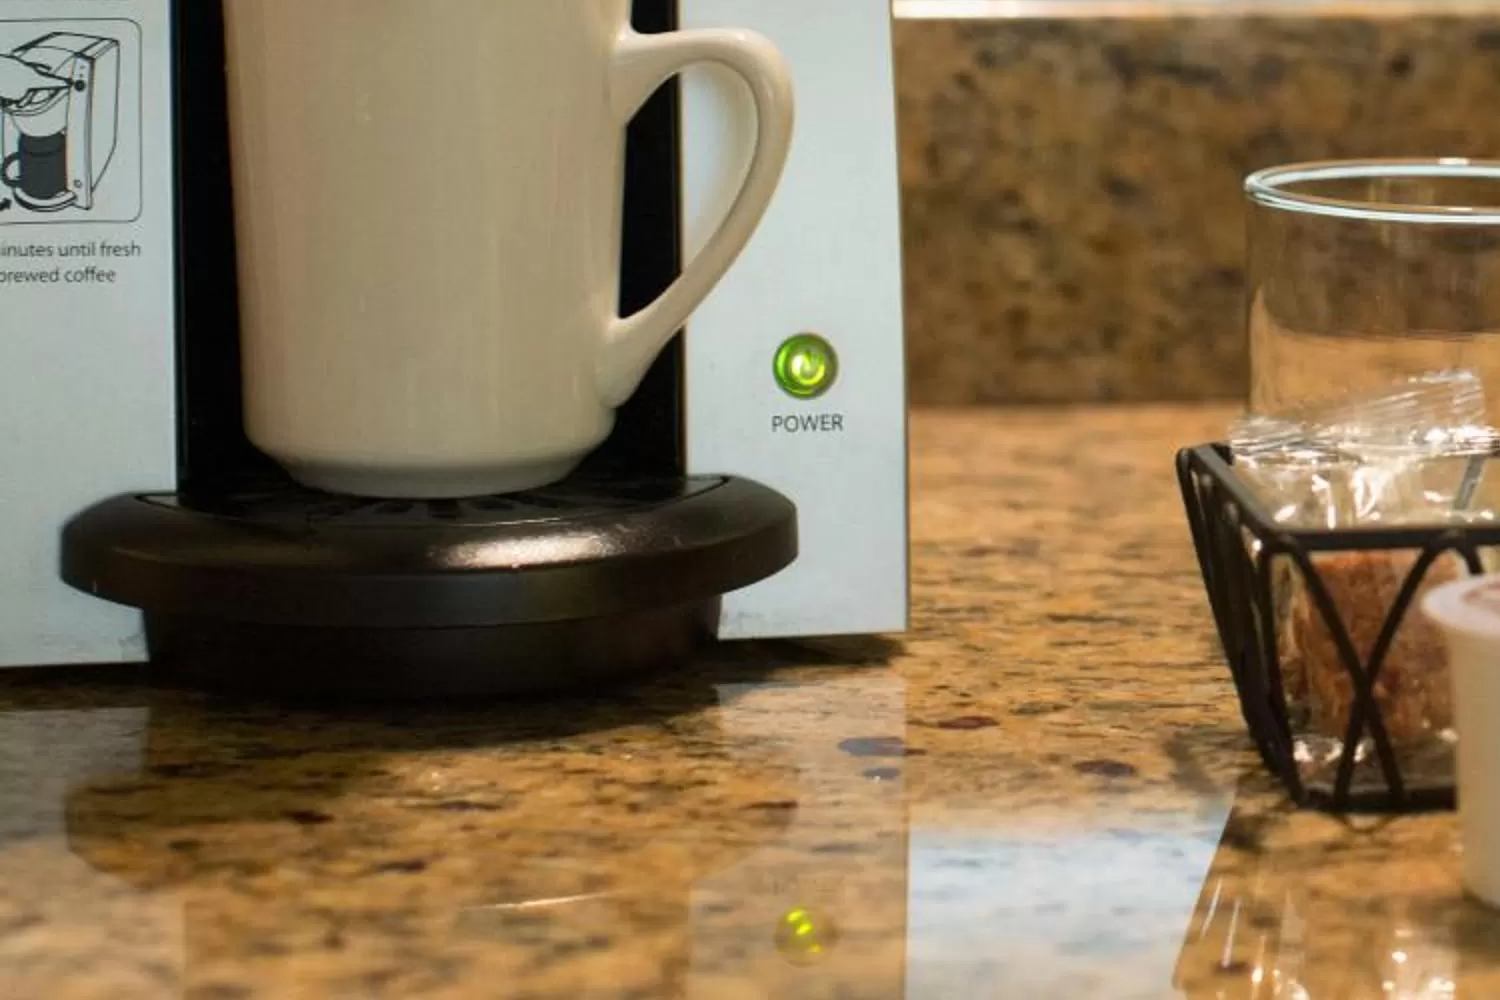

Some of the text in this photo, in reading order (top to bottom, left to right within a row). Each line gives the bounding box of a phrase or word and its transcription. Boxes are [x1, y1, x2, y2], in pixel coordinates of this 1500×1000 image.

[0, 240, 141, 257] inutes until fresh
[64, 266, 116, 283] coffee
[771, 413, 843, 433] POWER
